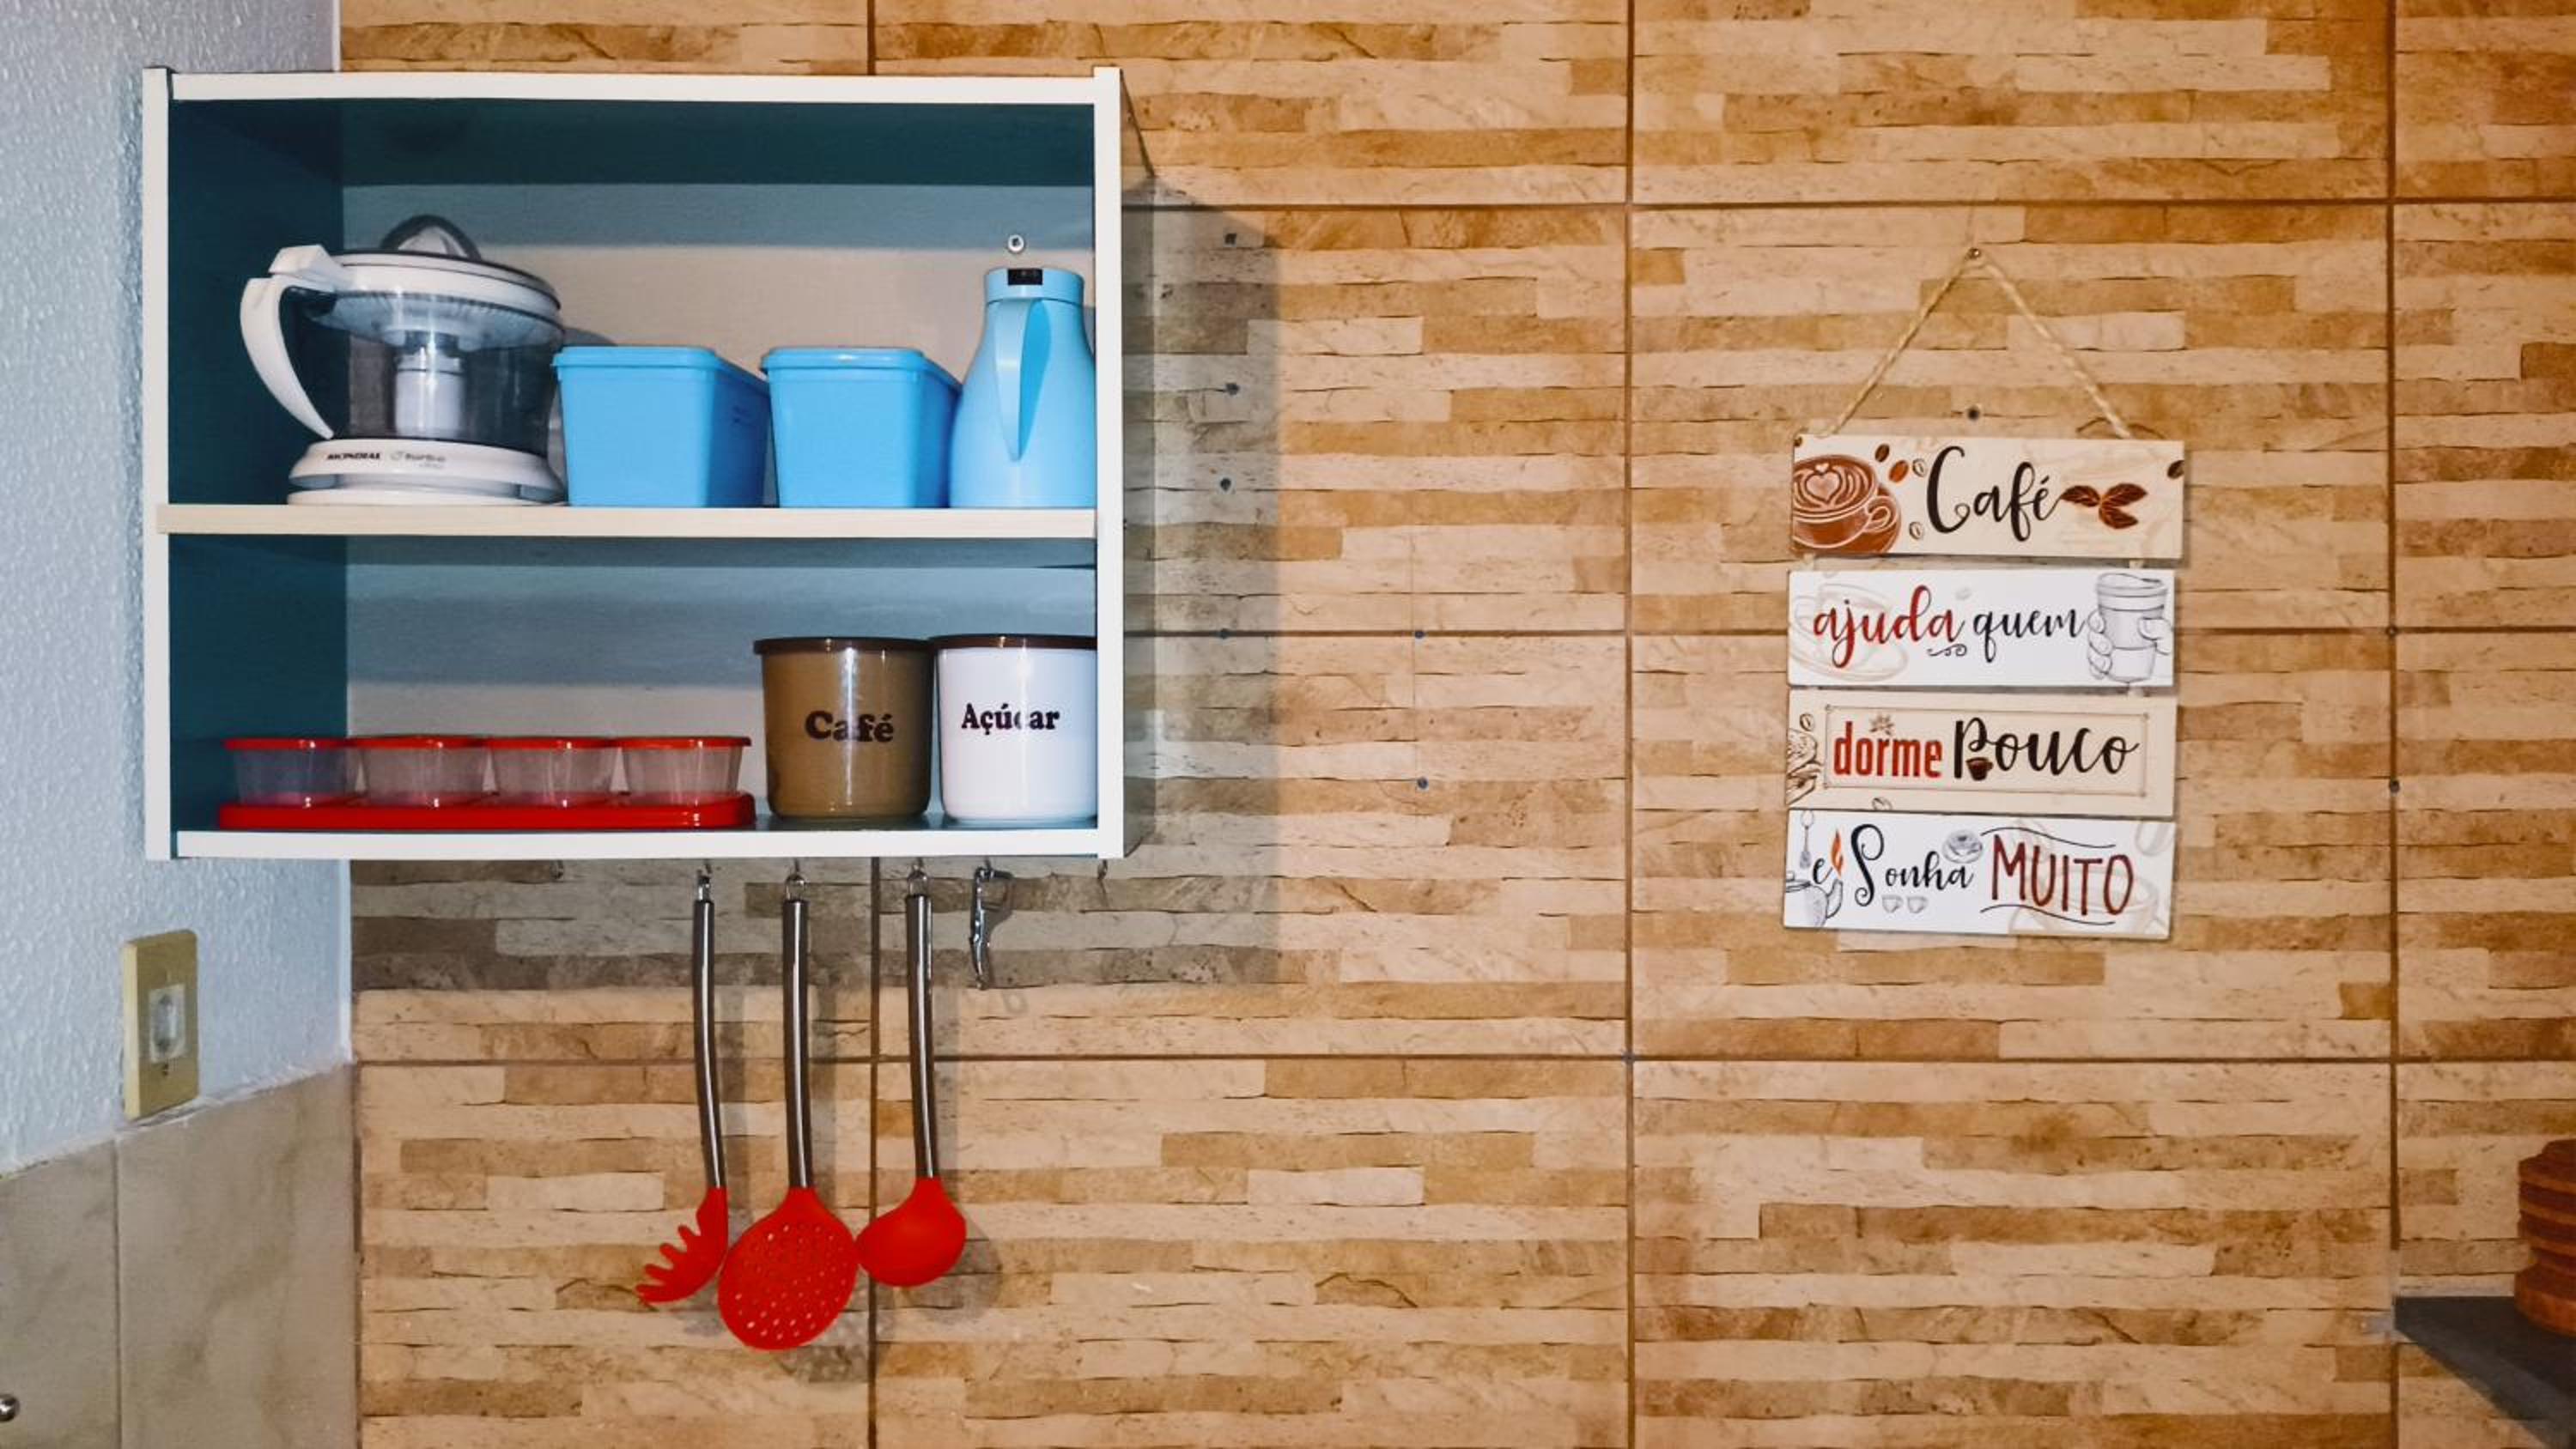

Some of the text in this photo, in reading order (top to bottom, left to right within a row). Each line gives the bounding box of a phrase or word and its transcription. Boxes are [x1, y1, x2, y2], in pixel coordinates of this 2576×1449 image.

[1926, 446, 2061, 542] Café
[1814, 585, 2087, 668] ajuda quem
[805, 710, 894, 743] Café
[1833, 720, 1942, 779] dorme
[1812, 823, 2134, 917] e Sonha MUITO
